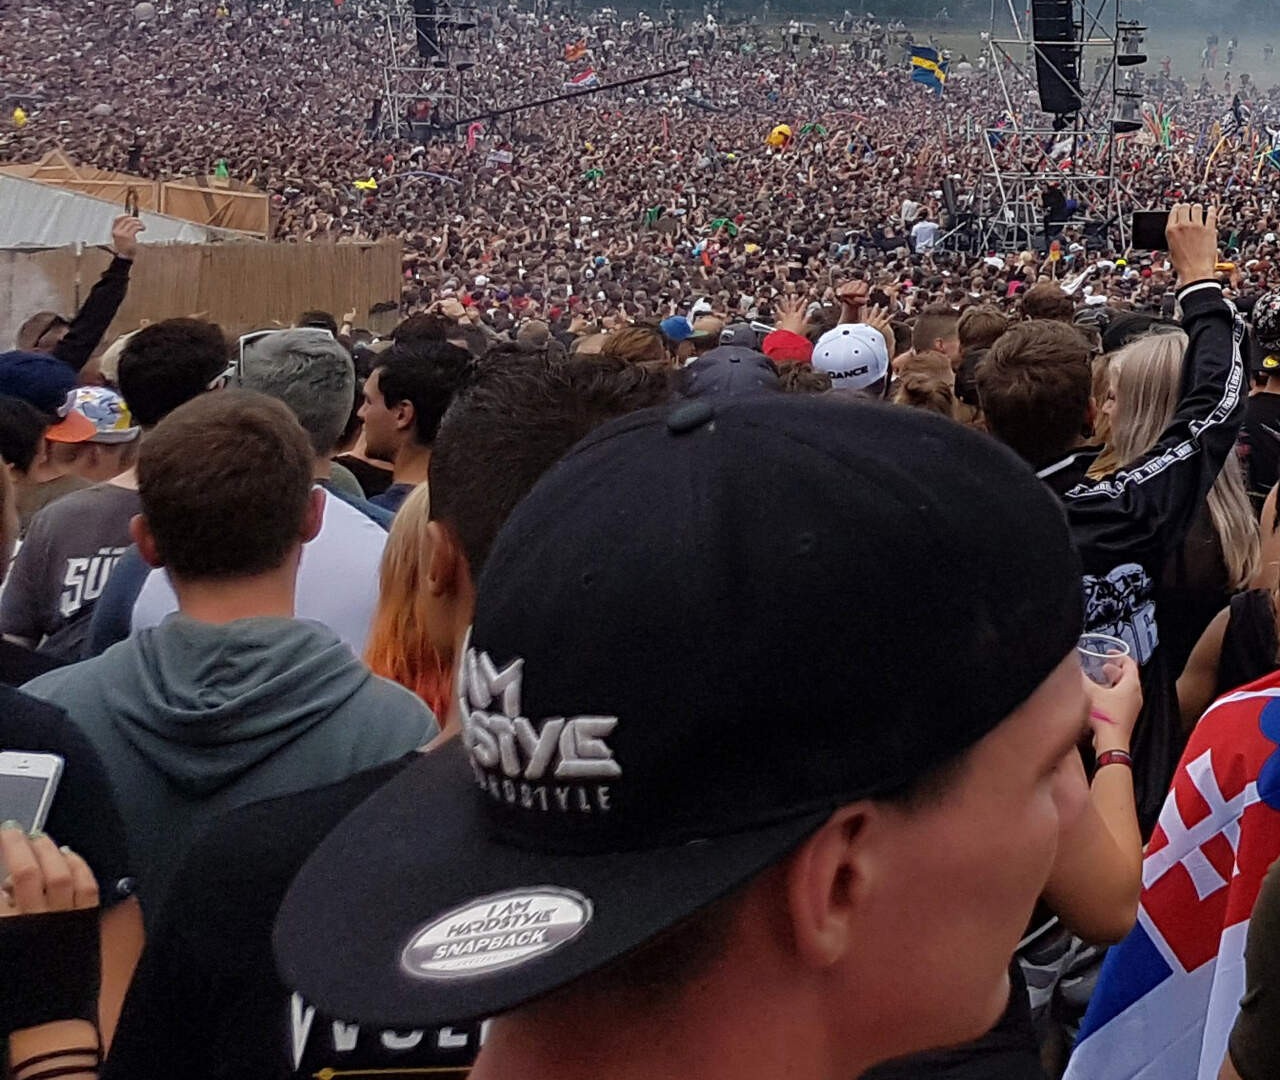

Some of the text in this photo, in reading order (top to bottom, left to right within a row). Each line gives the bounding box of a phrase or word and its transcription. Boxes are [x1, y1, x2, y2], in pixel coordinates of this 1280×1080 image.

[446, 906, 559, 938] HARDSTYLE
[486, 899, 533, 918] I AM
[432, 928, 548, 960] SNAPBACK
